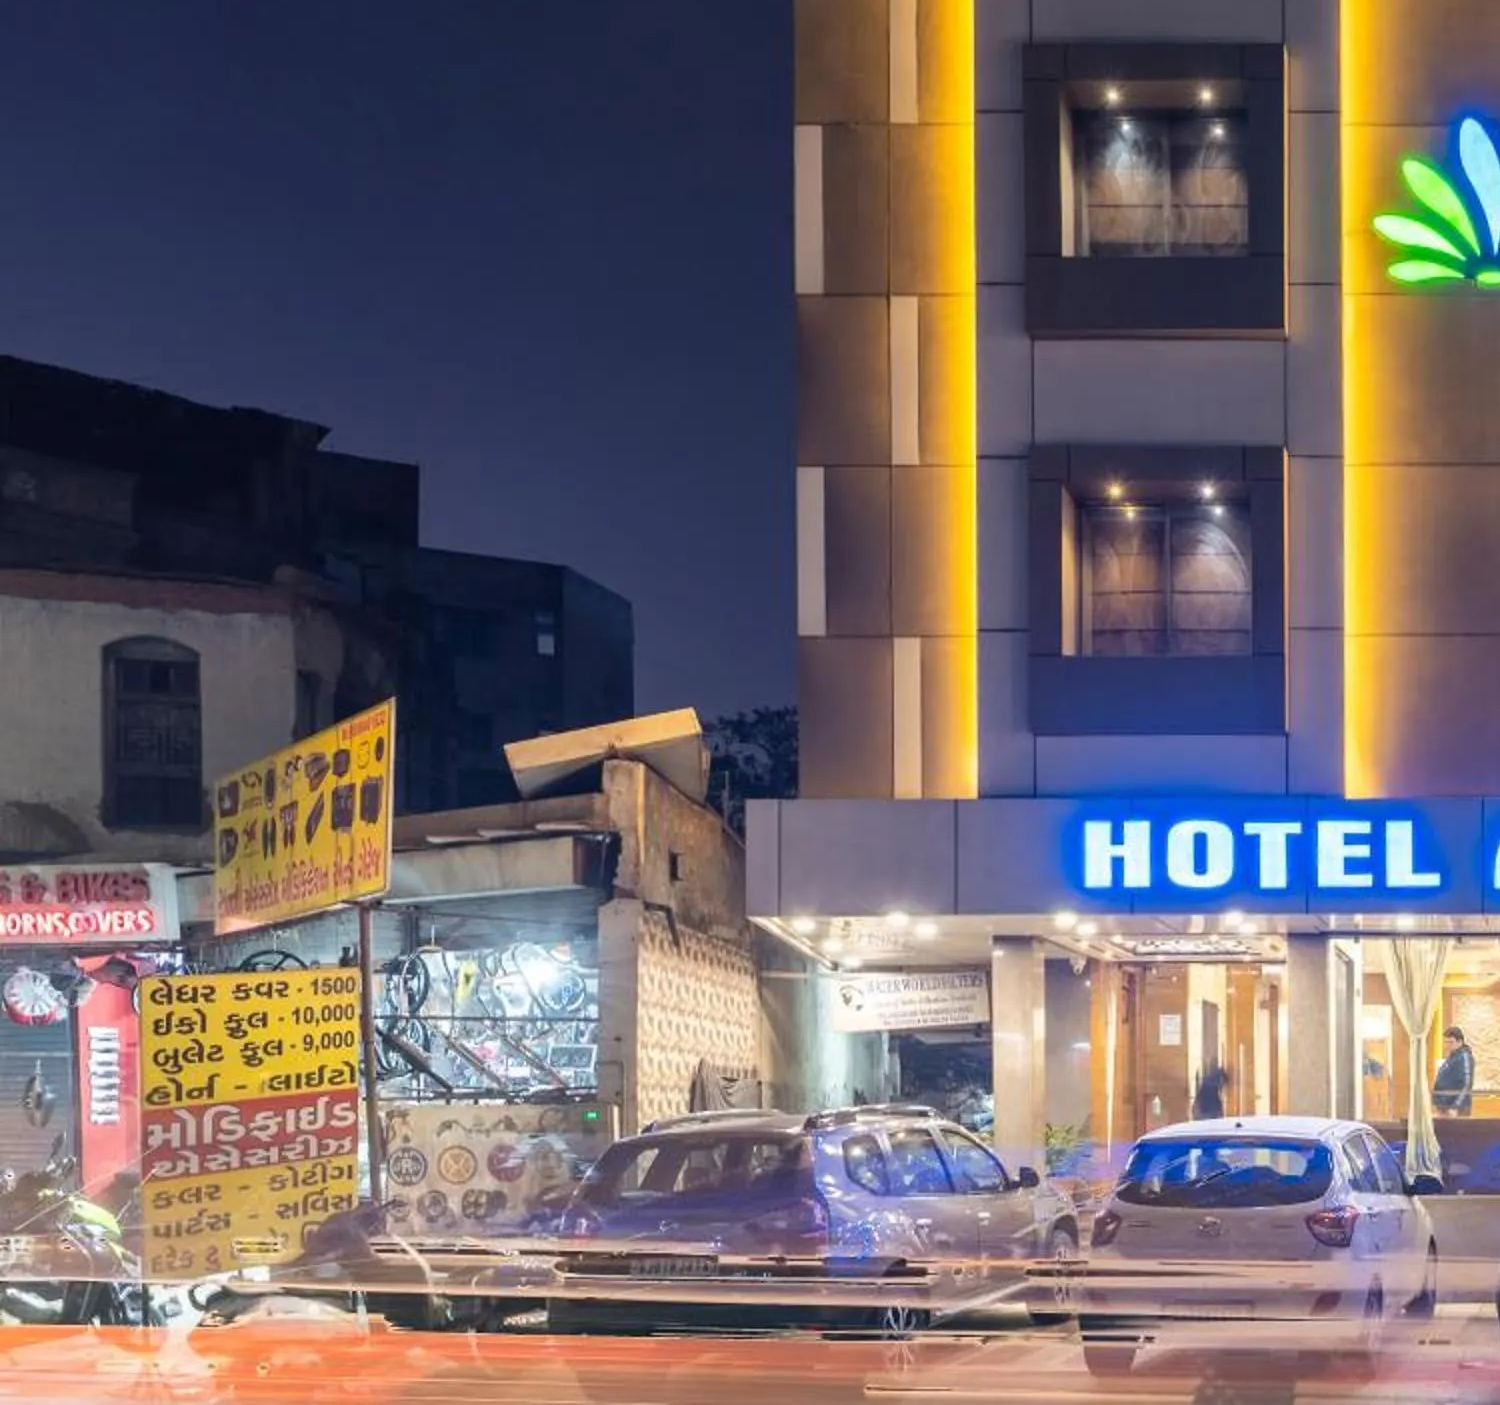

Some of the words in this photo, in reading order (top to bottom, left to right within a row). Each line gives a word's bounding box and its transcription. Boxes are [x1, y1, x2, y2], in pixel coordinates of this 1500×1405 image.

[1083, 820, 1441, 889] HOTEL
[310, 976, 356, 996] 1500
[292, 1003, 355, 1027] 10,000
[303, 1030, 355, 1054] 9,000
